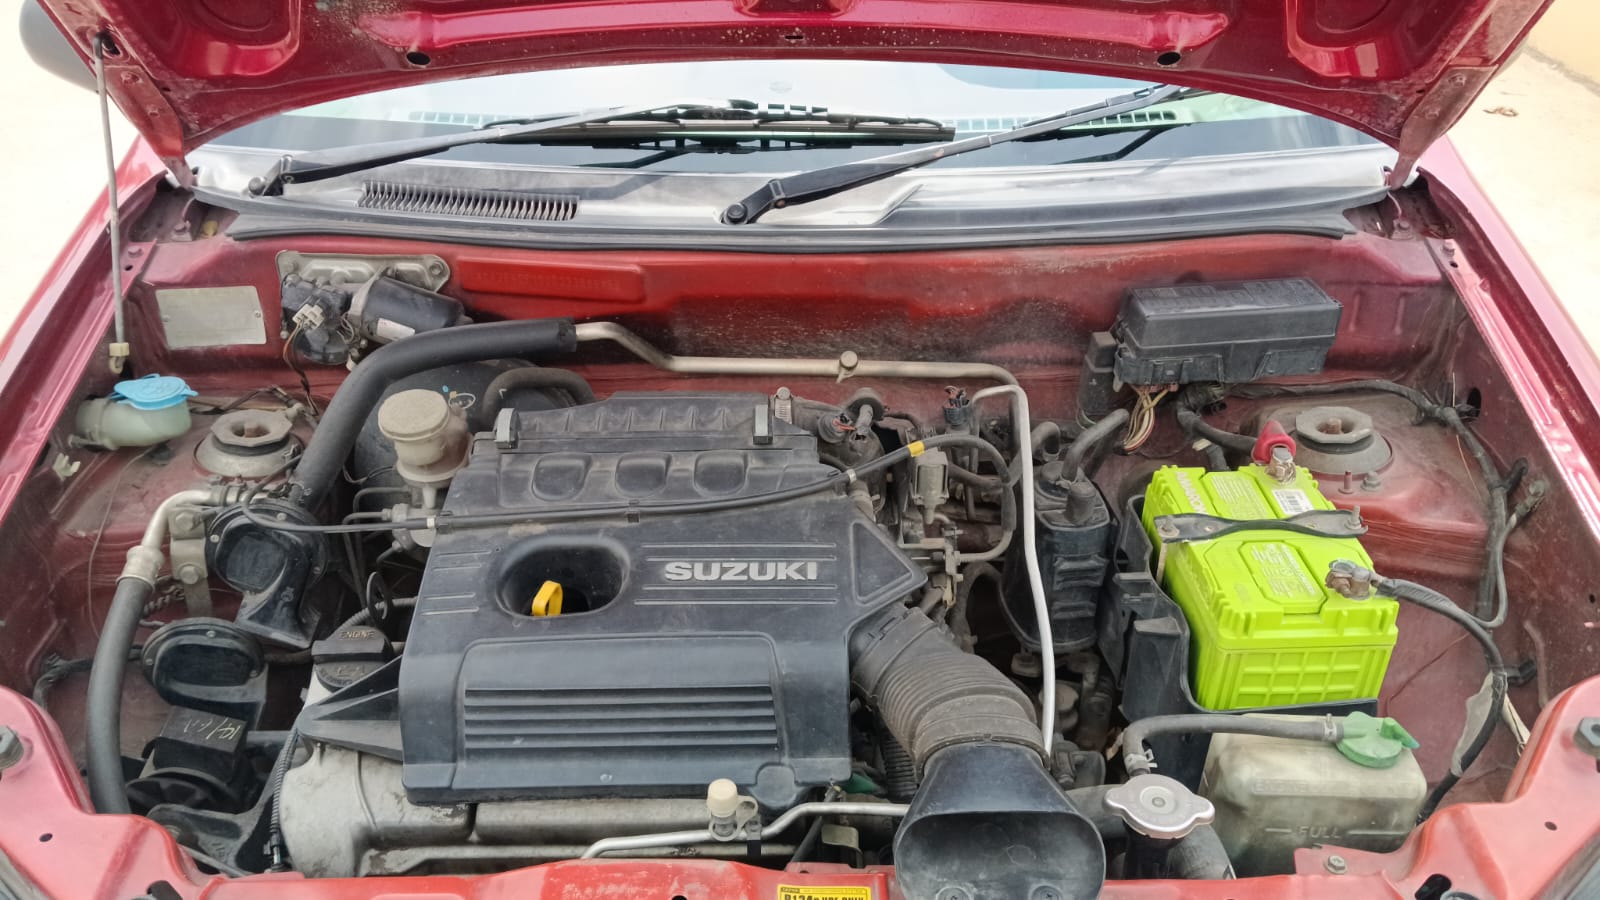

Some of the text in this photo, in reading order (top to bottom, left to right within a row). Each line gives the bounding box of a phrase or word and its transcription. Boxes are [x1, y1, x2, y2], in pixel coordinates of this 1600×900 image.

[664, 561, 818, 582] SUZUKI
[340, 630, 375, 638] ENGINE
[1299, 826, 1342, 839] FULL
